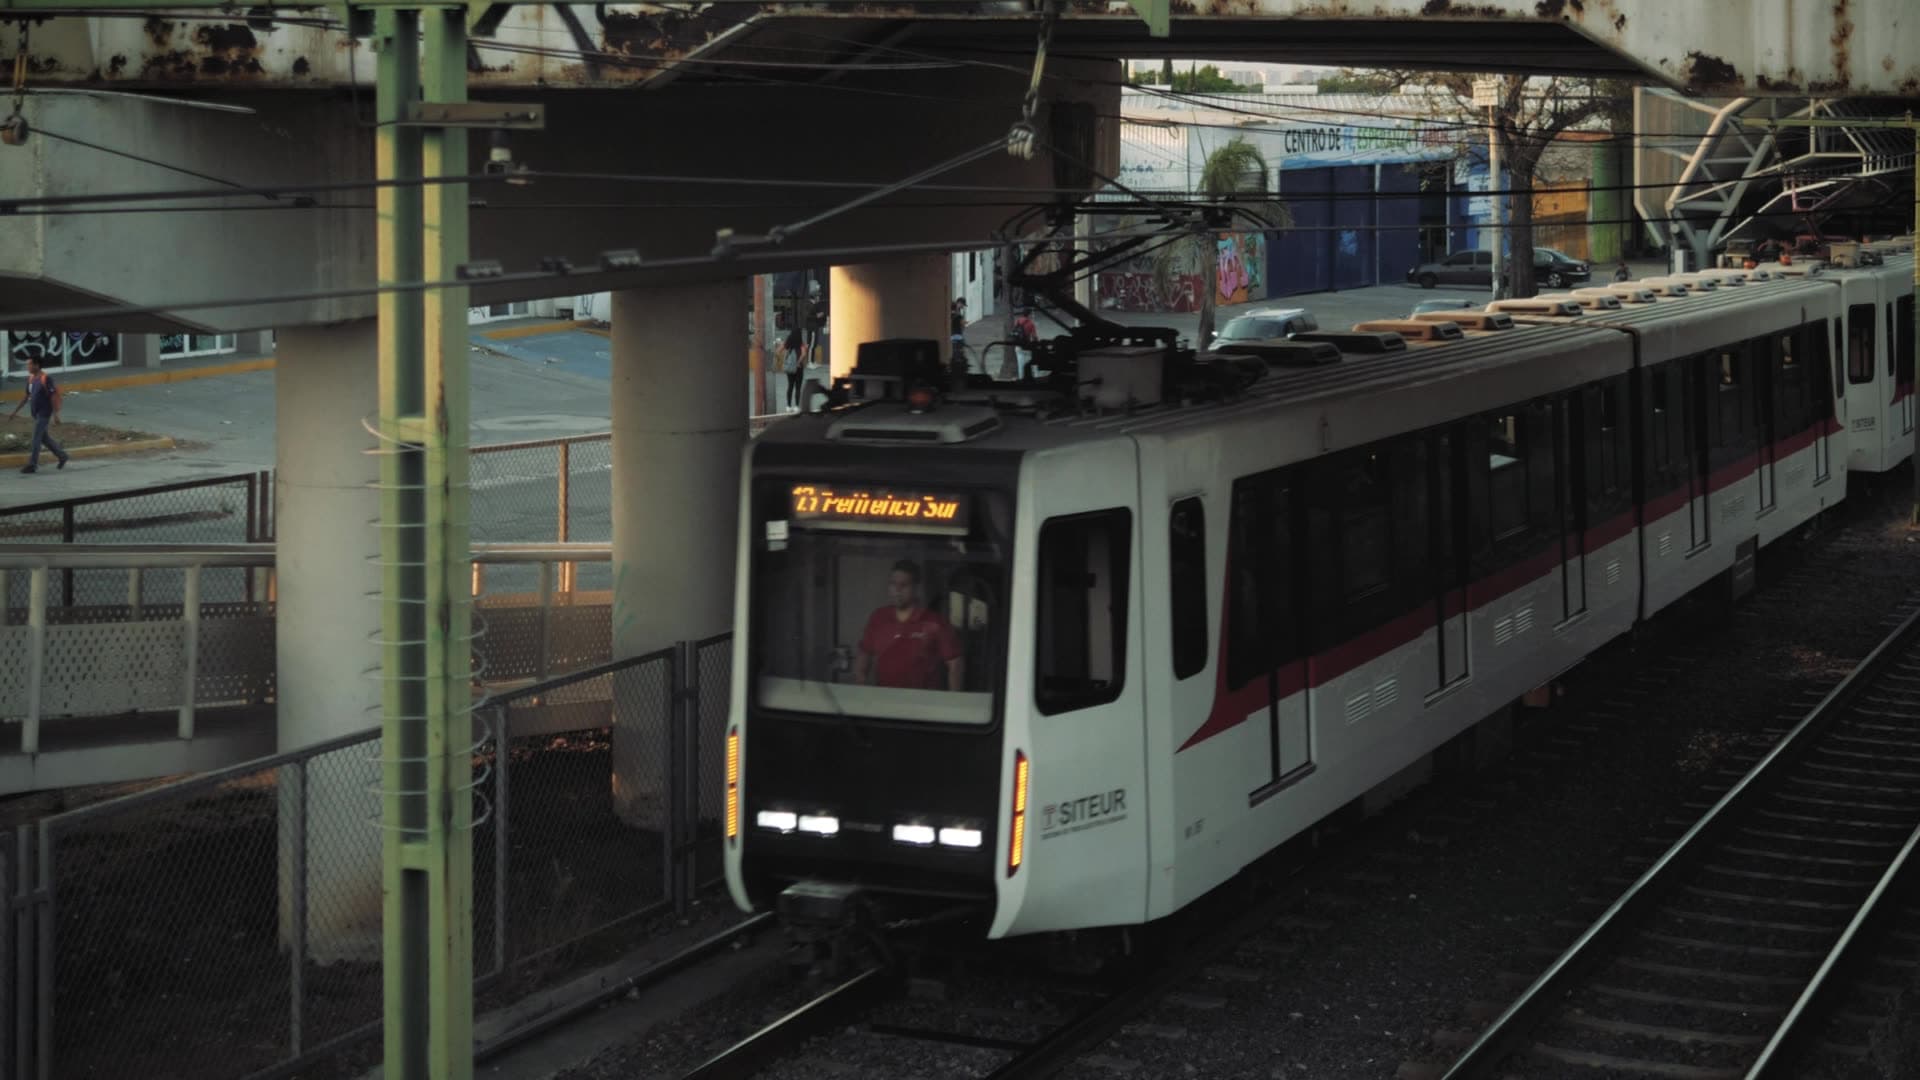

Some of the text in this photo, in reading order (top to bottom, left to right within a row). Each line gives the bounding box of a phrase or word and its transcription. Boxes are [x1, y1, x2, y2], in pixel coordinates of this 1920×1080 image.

[1284, 128, 1326, 153] CENTRO
[1328, 128, 1341, 150] DE
[923, 496, 959, 519] Sur
[1058, 788, 1127, 826] SITEUR
